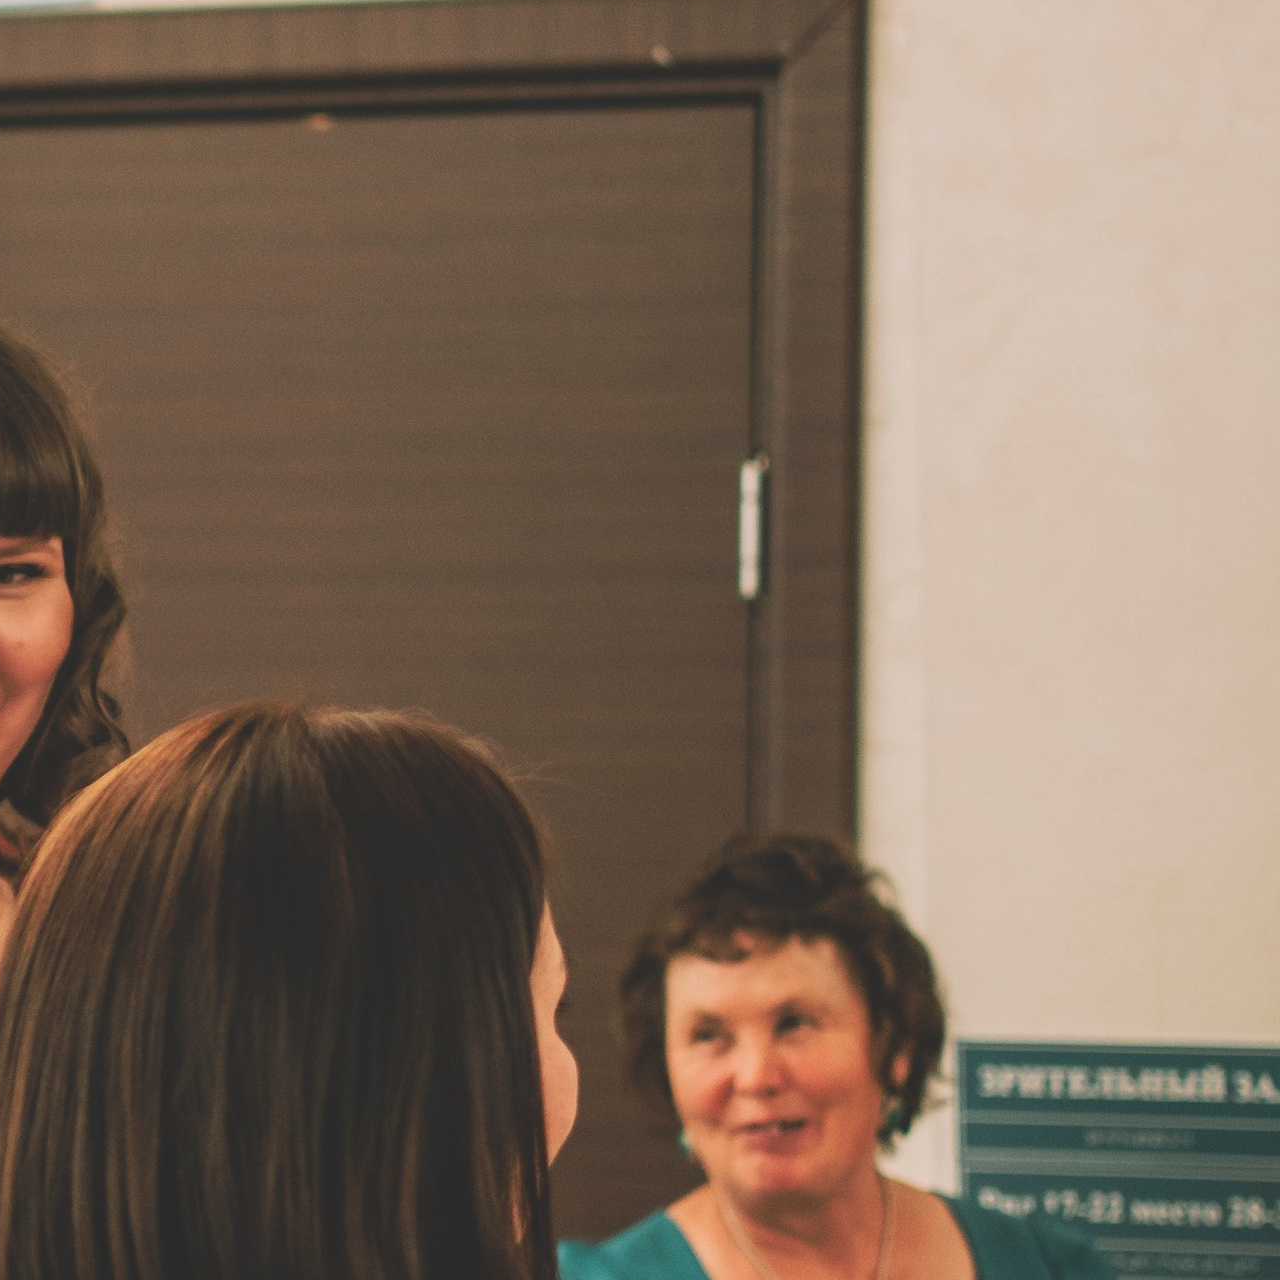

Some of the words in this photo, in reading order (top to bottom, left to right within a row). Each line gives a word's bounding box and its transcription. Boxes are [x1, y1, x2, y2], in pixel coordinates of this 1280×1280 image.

[978, 1063, 1226, 1103] ЗРИТЕЛЬНЫЙ
[1233, 1069, 1280, 1104] ЗА
[1043, 1190, 1125, 1224] 17-22
[1228, 1196, 1280, 1229] 28-
